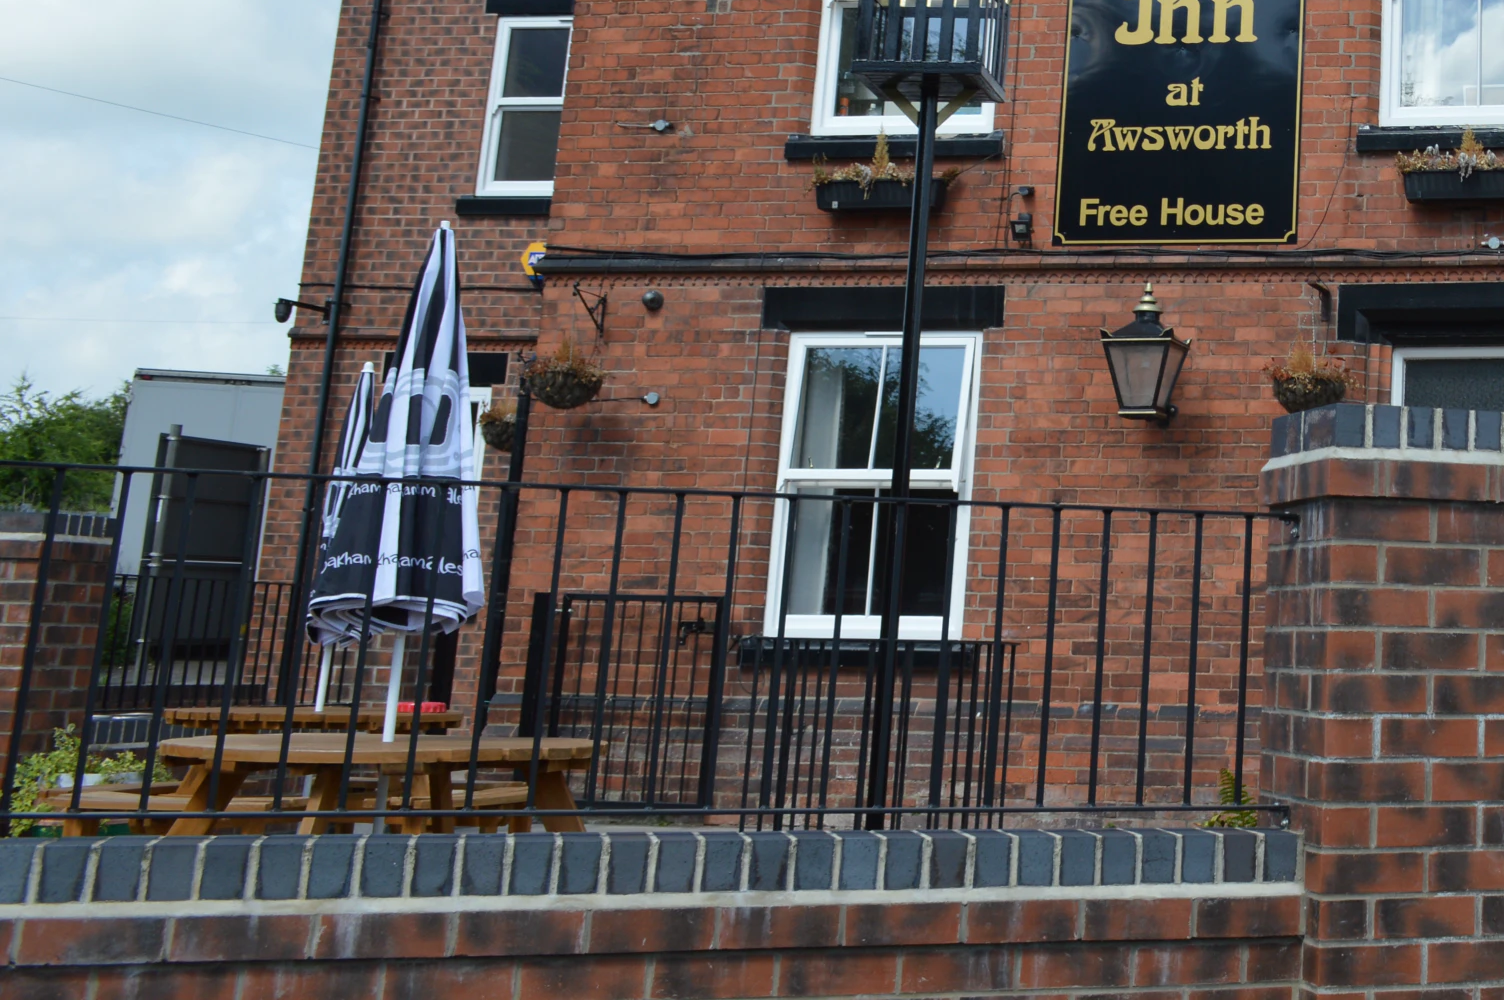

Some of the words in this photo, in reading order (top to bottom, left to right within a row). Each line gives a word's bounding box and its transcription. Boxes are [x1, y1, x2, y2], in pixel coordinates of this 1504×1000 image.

[1166, 77, 1204, 106] at
[1088, 117, 1271, 151] Awsworth
[1080, 199, 1148, 226] Free
[1161, 198, 1264, 225] House
